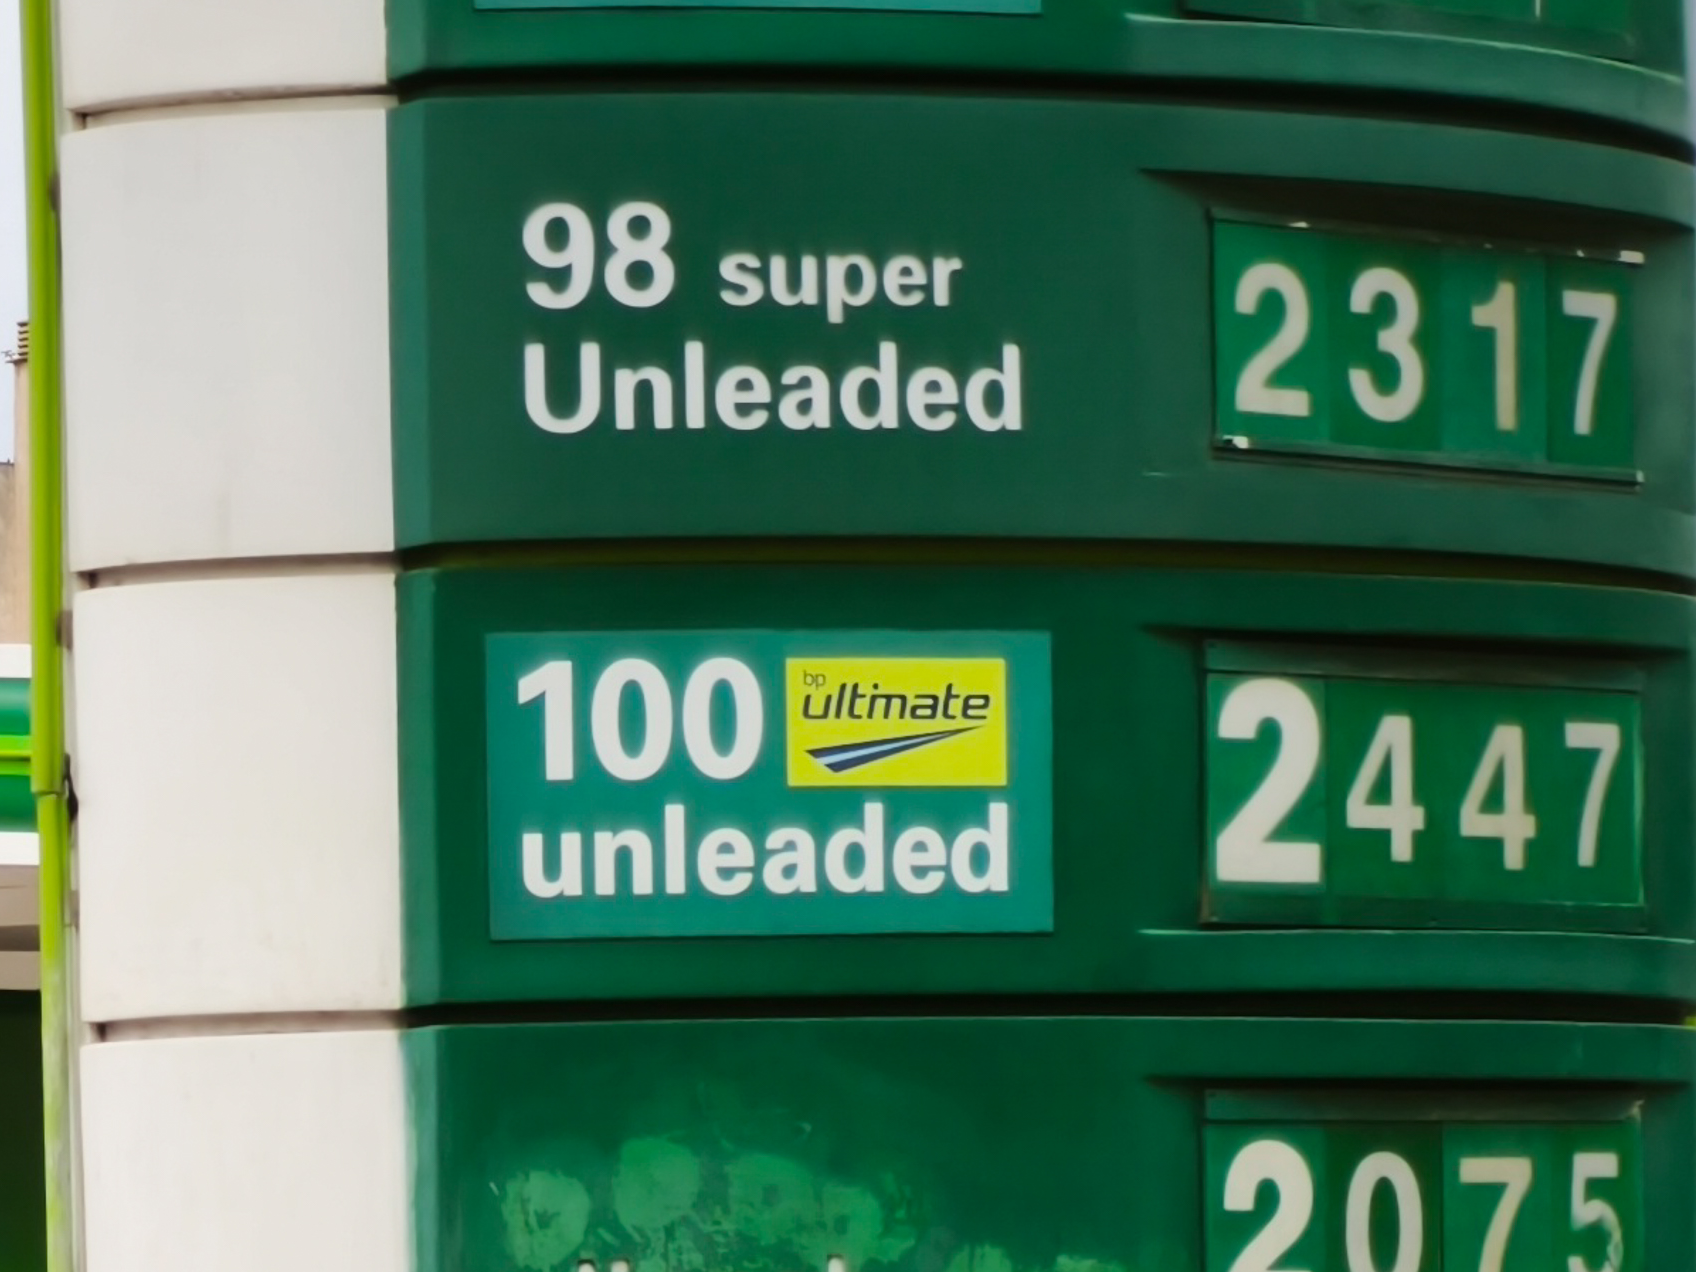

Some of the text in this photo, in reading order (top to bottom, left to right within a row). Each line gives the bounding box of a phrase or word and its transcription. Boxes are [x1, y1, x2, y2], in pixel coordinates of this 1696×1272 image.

[522, 203, 962, 322] 98 super
[523, 341, 1023, 433] Unleaded
[1232, 262, 1620, 436] 2317
[515, 657, 763, 781] 100
[802, 669, 826, 690] bp
[802, 682, 991, 720] ultimate
[1214, 677, 1622, 885] 2447
[520, 802, 1011, 898] unleaded
